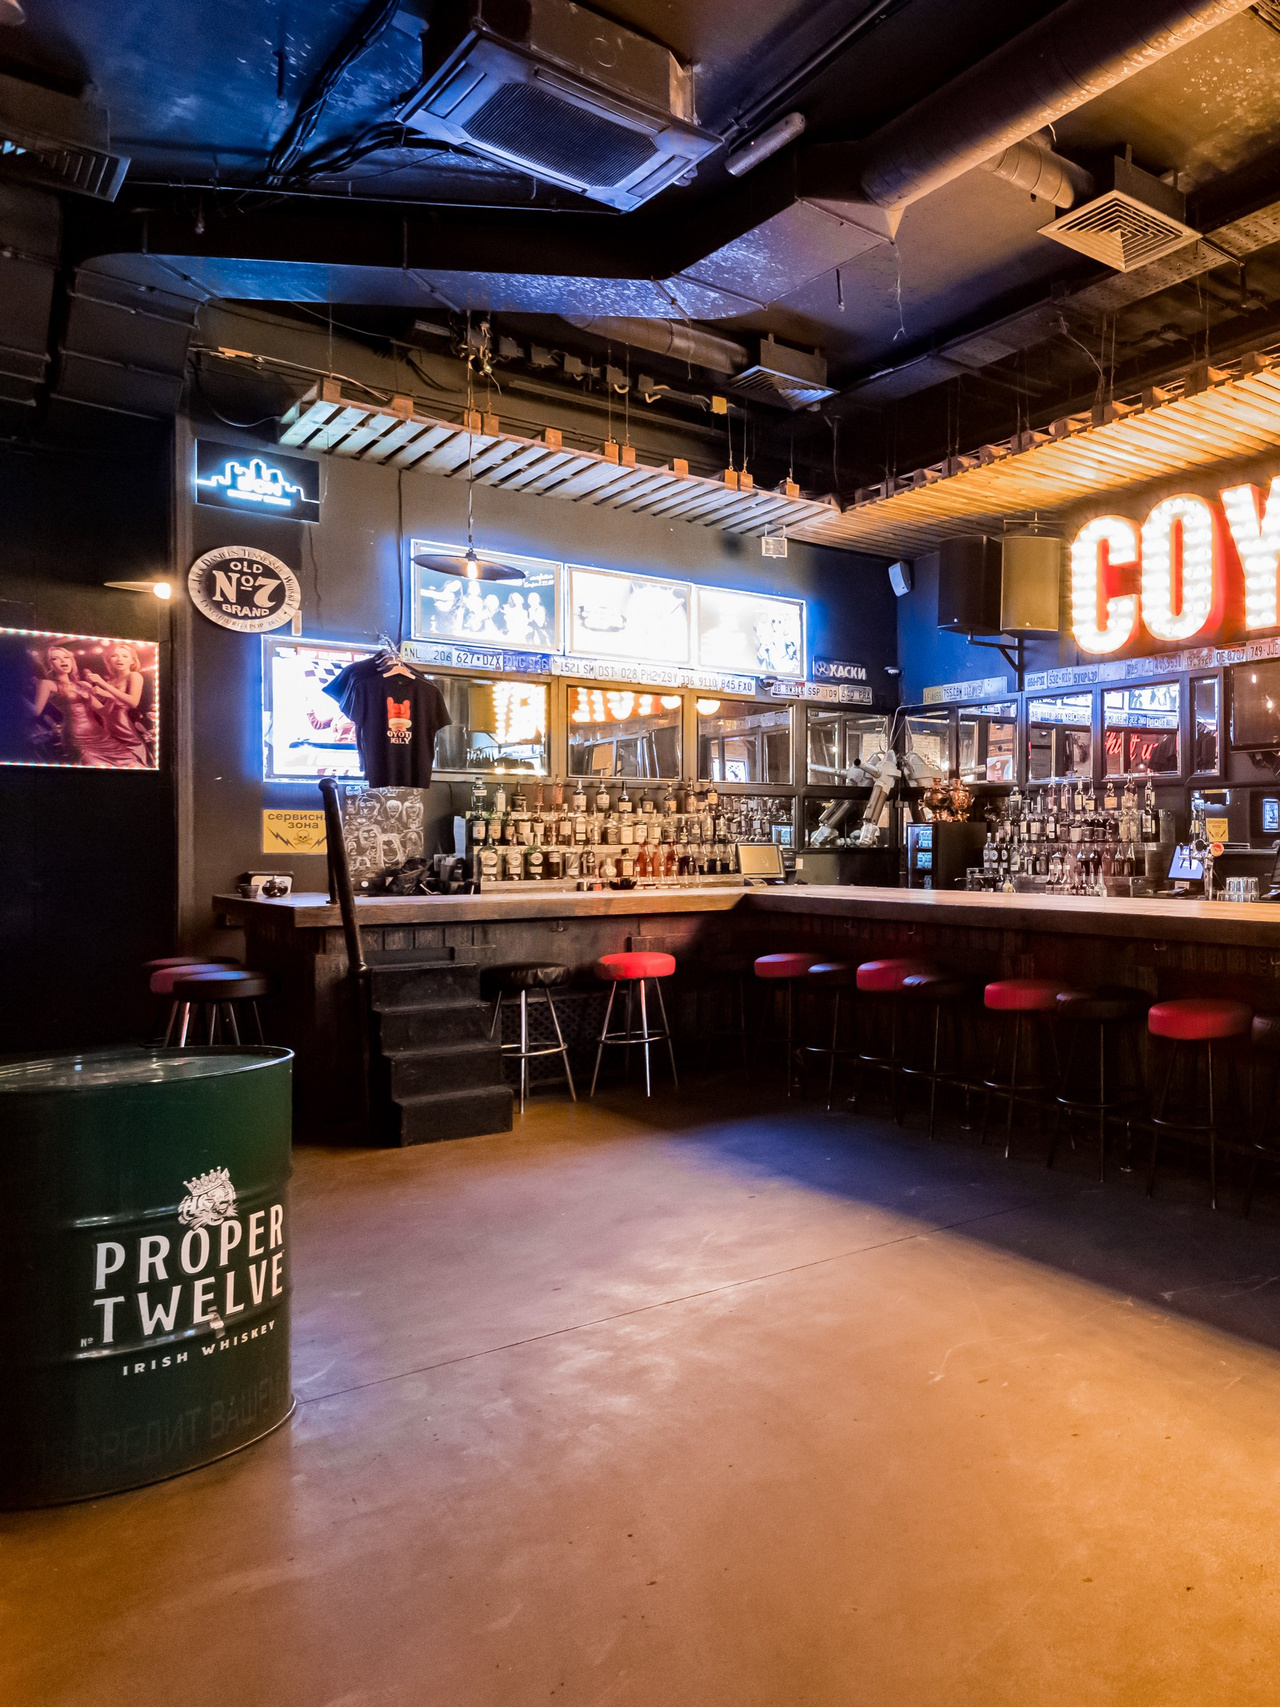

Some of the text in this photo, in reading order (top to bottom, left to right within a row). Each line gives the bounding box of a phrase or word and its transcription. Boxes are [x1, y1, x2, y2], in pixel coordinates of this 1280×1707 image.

[229, 560, 264, 574] OLD
[221, 603, 270, 618] BRAND
[433, 649, 452, 662] 206
[620, 668, 638, 680] 028
[828, 663, 867, 681] ХАСКИ
[720, 679, 736, 690] 845
[267, 811, 326, 822] сервисн
[287, 820, 319, 830] зона
[94, 1203, 284, 1291] PROPER
[94, 1253, 284, 1345] TWELVE
[122, 1319, 276, 1377] IRISH WHISKEY
